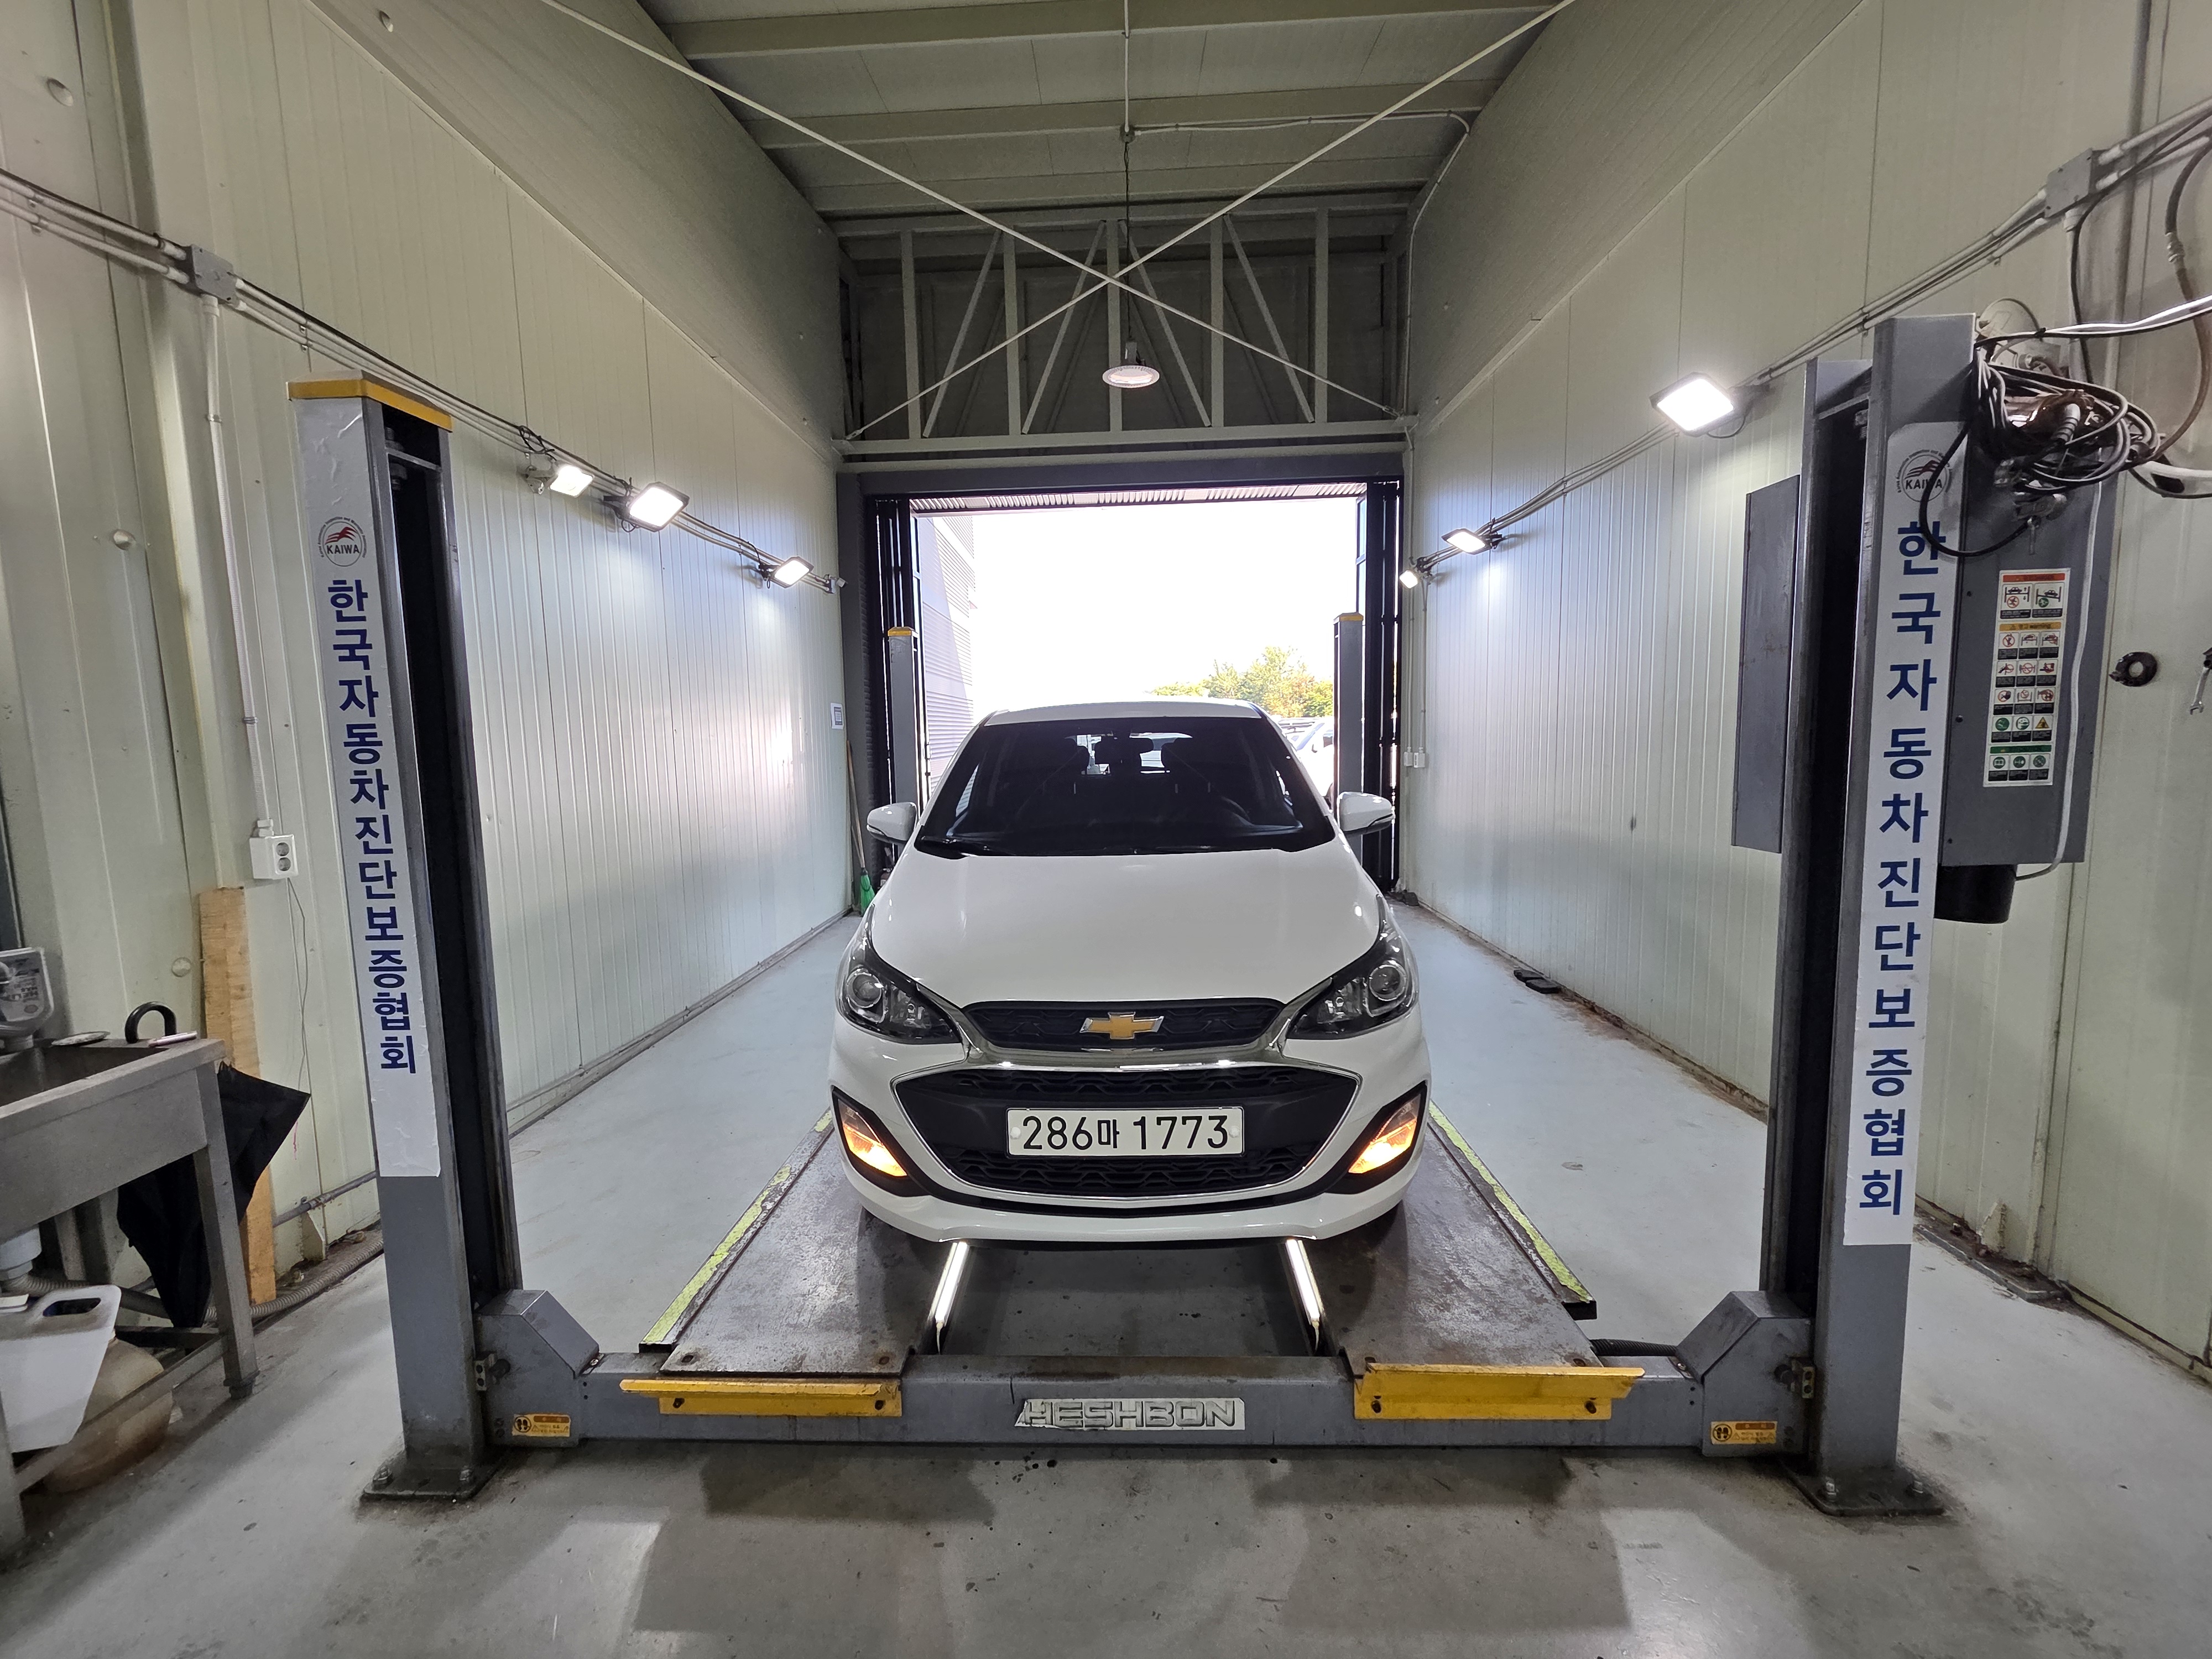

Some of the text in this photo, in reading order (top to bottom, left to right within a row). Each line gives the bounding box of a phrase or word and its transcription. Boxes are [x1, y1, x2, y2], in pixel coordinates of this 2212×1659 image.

[1906, 479, 1942, 489] KAIA
[326, 545, 360, 554] KAIWA
[328, 580, 416, 1073] 한국자동차진단보증협회
[1859, 521, 1946, 1215] 한국자동차진단보증협회
[1022, 1115, 1228, 1150] 286마 1773
[1024, 1400, 1235, 1428] HESHBON
